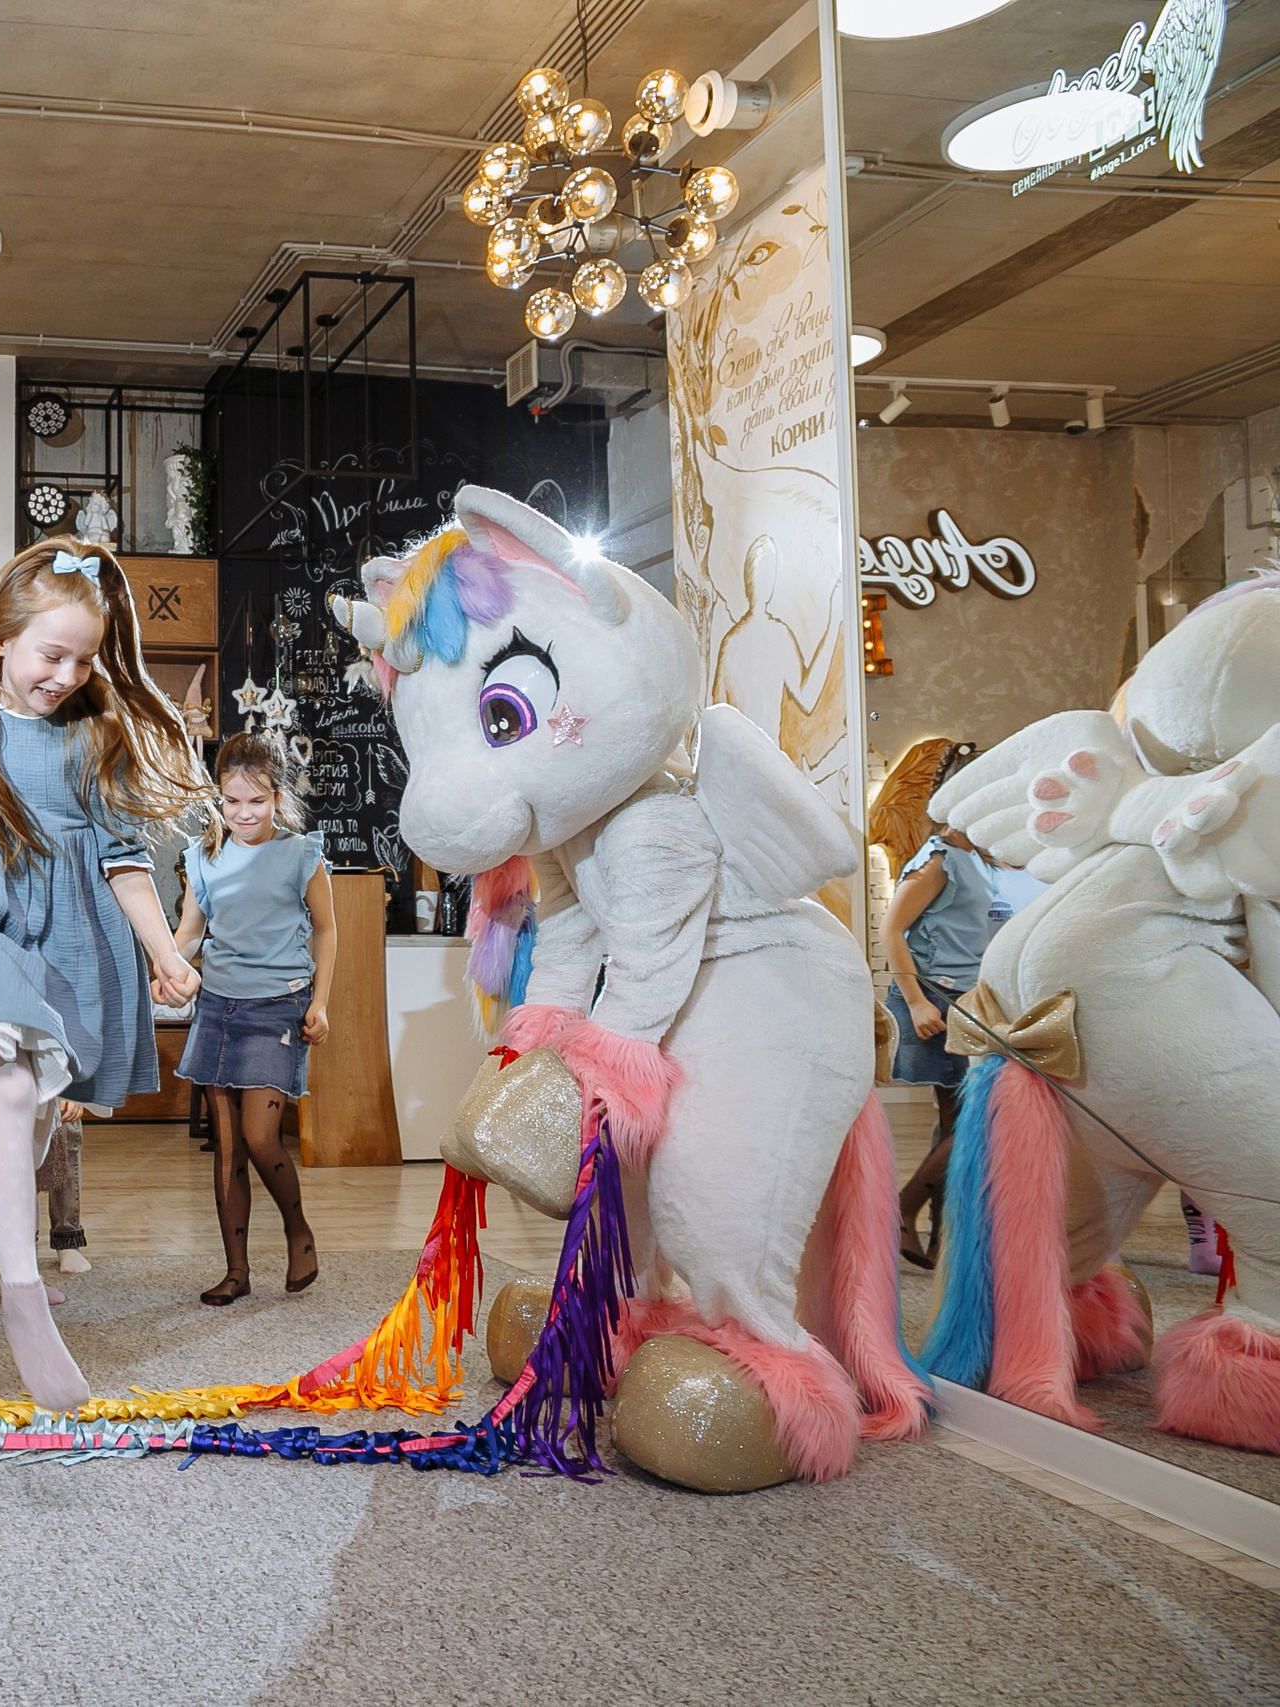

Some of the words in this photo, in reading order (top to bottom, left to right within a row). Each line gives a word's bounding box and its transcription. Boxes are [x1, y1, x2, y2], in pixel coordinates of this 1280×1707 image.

[771, 411, 825, 457] КОРНИ
[309, 750, 344, 763] АРИТЬ
[346, 818, 358, 833] ТО
